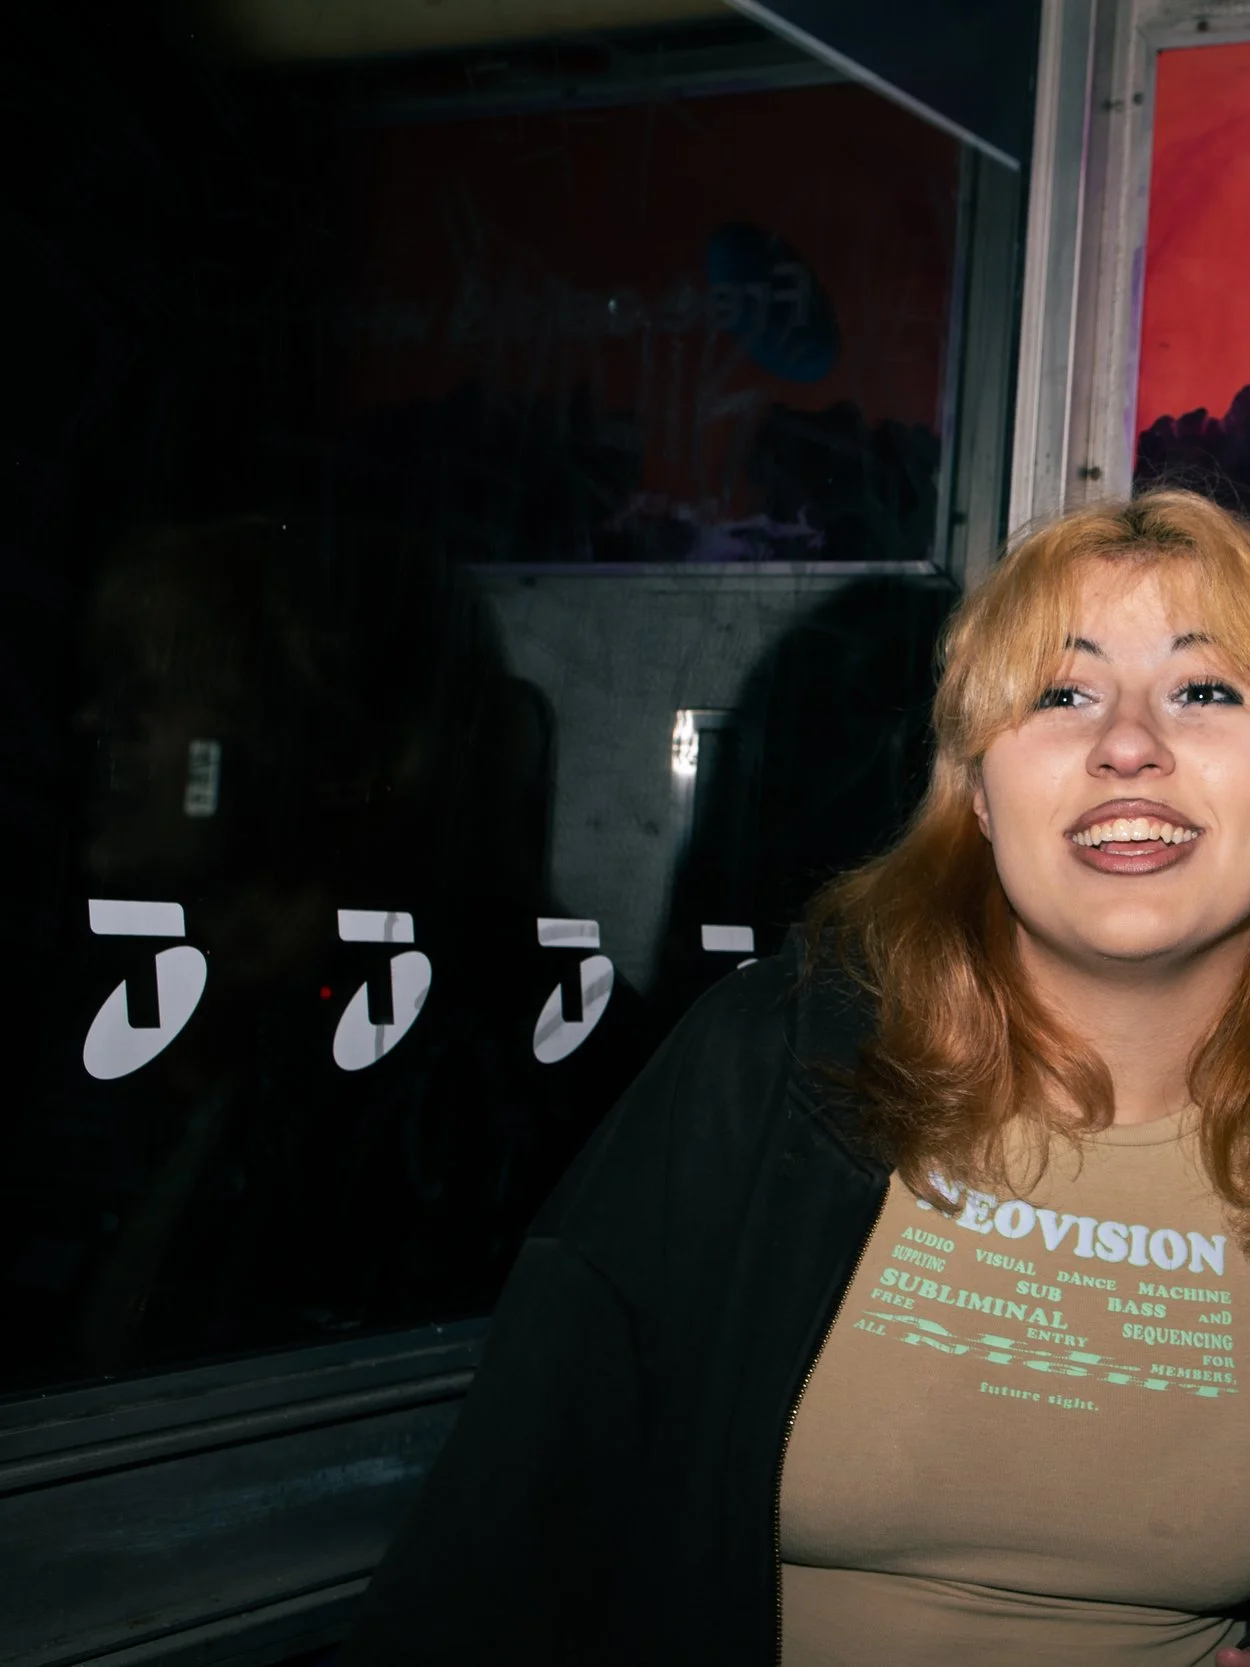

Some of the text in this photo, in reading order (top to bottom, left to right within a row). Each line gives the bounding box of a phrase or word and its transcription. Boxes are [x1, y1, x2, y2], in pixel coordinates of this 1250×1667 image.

[891, 1244, 947, 1273] SUPPLYING
[1016, 1280, 1063, 1302] SUB
[1107, 1297, 1167, 1319] BASS
[901, 1226, 1232, 1304] AUDIO VISUAL DANCE MACHINE
[854, 1319, 886, 1336] ALL
[871, 1288, 1236, 1369] FREE ENTRY FOR
[880, 1267, 1233, 1351] SUBLIMINAL SEQUENCING
[980, 1382, 1099, 1412] future sight.
